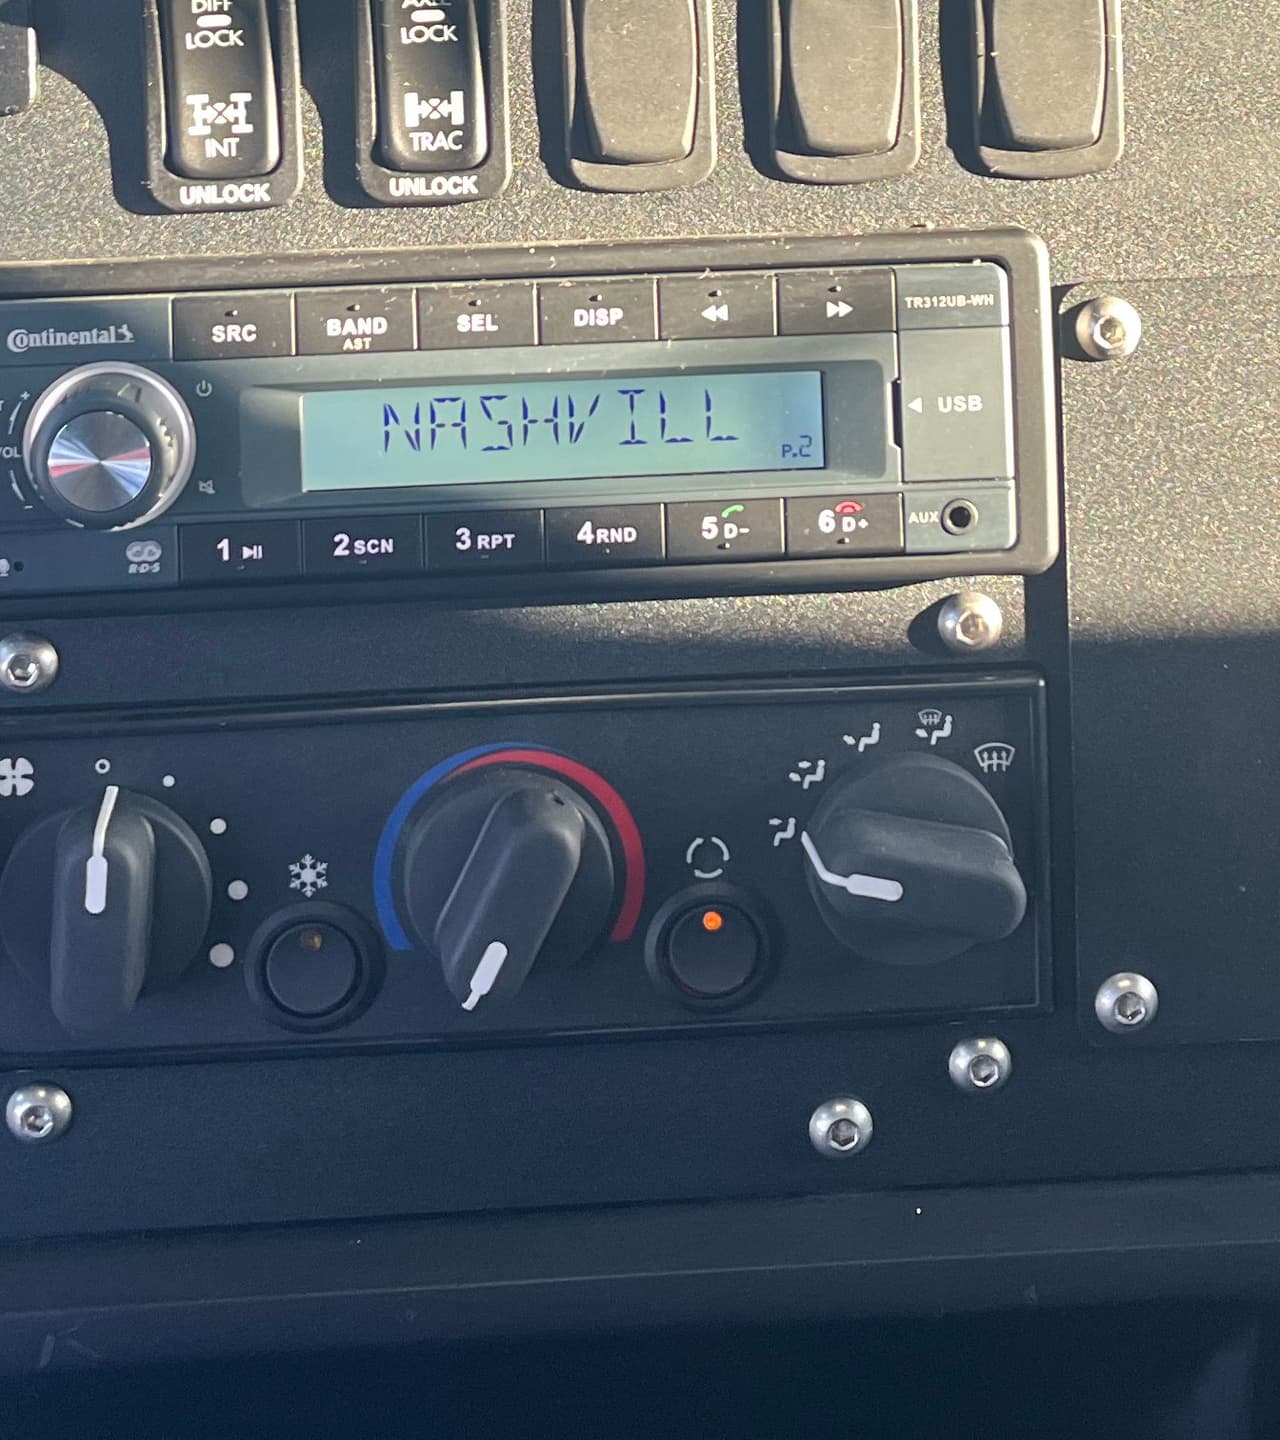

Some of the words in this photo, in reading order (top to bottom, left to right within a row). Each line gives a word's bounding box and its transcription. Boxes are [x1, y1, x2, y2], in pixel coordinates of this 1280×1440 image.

[185, 30, 244, 50] LOCK
[401, 25, 458, 45] LOCK
[205, 138, 240, 158] INT
[409, 131, 464, 152] TRAC
[180, 183, 271, 205] UNLOCK
[389, 175, 478, 197] UNLOCK
[905, 294, 994, 311] TR312UB-WH
[326, 316, 388, 337] BAND
[457, 313, 498, 333] SEL
[573, 307, 624, 328] DISP
[7, 325, 116, 353] Continental
[212, 324, 257, 344] SRC
[343, 337, 372, 350] AST
[938, 395, 983, 414] USB
[383, 388, 740, 453] NASHVILL
[701, 516, 719, 539] 5
[818, 510, 836, 533] 6
[908, 511, 939, 525] AUX
[456, 529, 471, 550] 3
[477, 533, 515, 549] RPT
[577, 522, 594, 543] 4
[596, 527, 637, 544] RND
[217, 539, 230, 561] 1
[334, 534, 349, 555] 2
[354, 538, 393, 554] SCN
